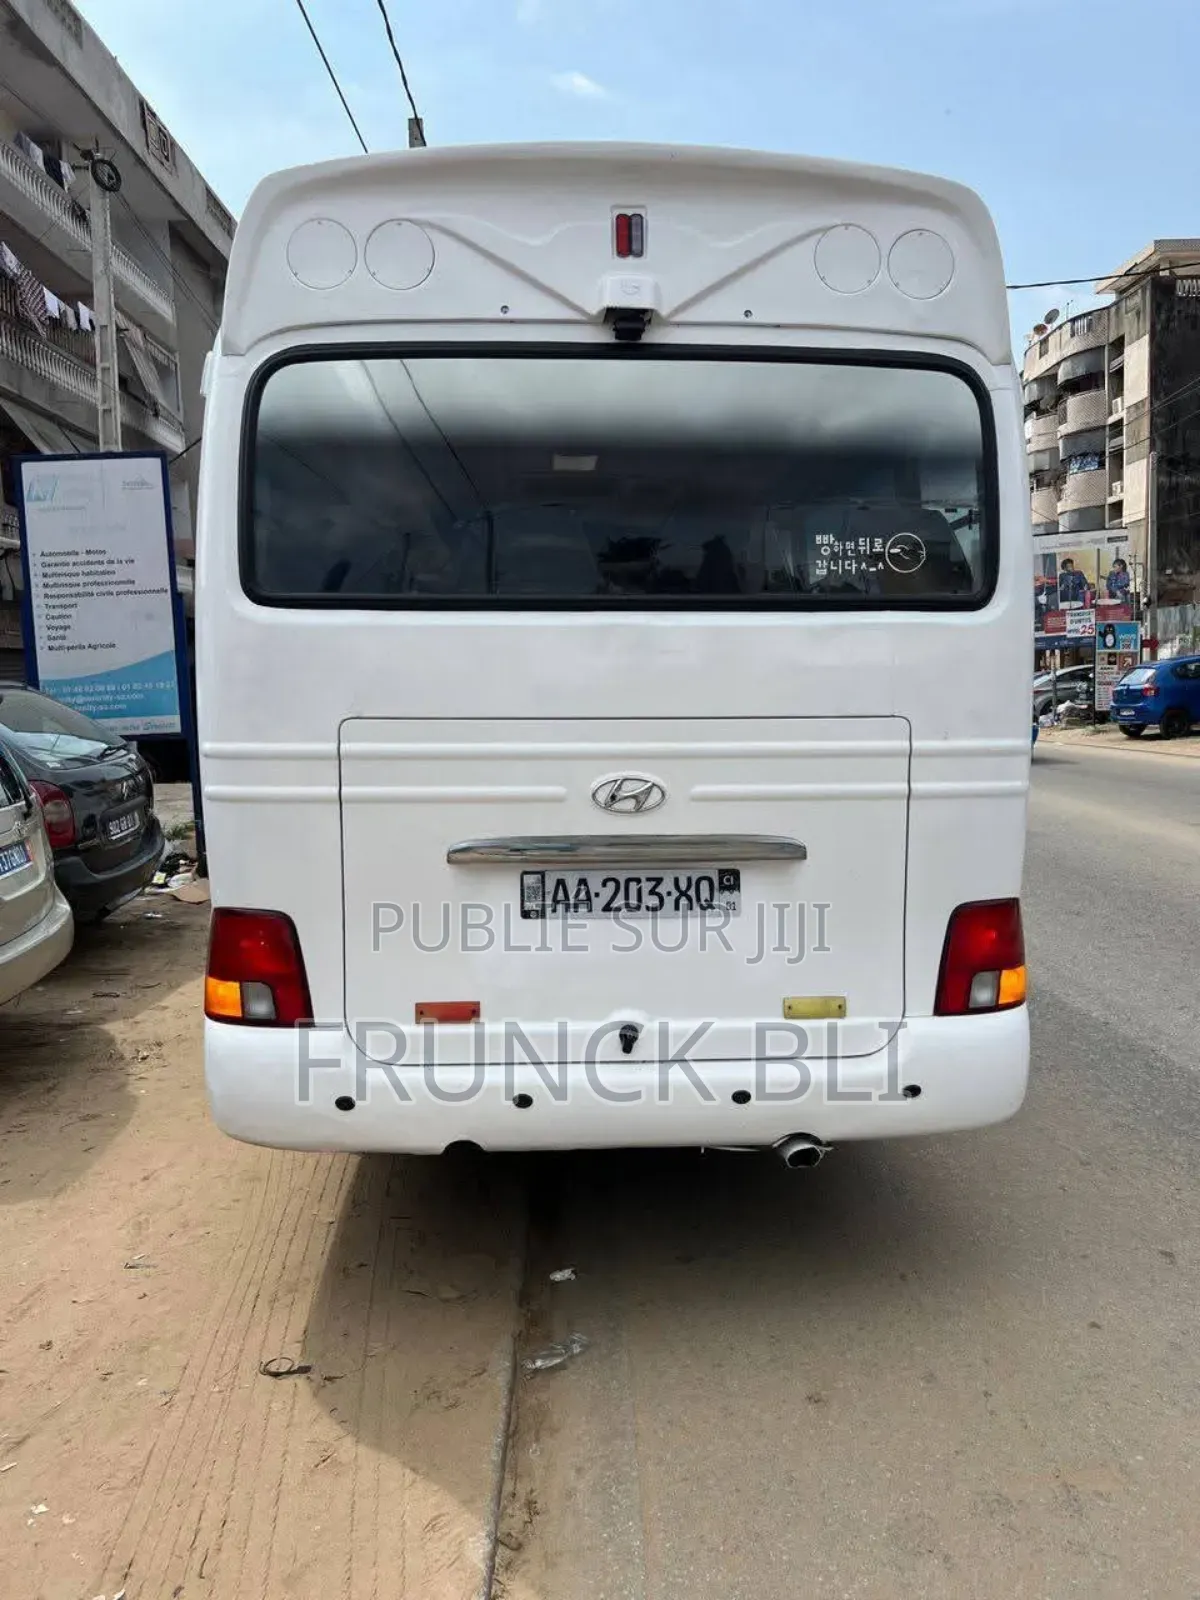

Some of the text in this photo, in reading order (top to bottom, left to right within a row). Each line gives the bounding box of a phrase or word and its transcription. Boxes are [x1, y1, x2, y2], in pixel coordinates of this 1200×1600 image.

[124, 557, 135, 565] vie
[115, 587, 169, 596] professionnelle
[46, 613, 72, 621] Caution
[1080, 623, 1095, 636] 25
[87, 642, 117, 651] Agricole
[723, 875, 734, 886] CI
